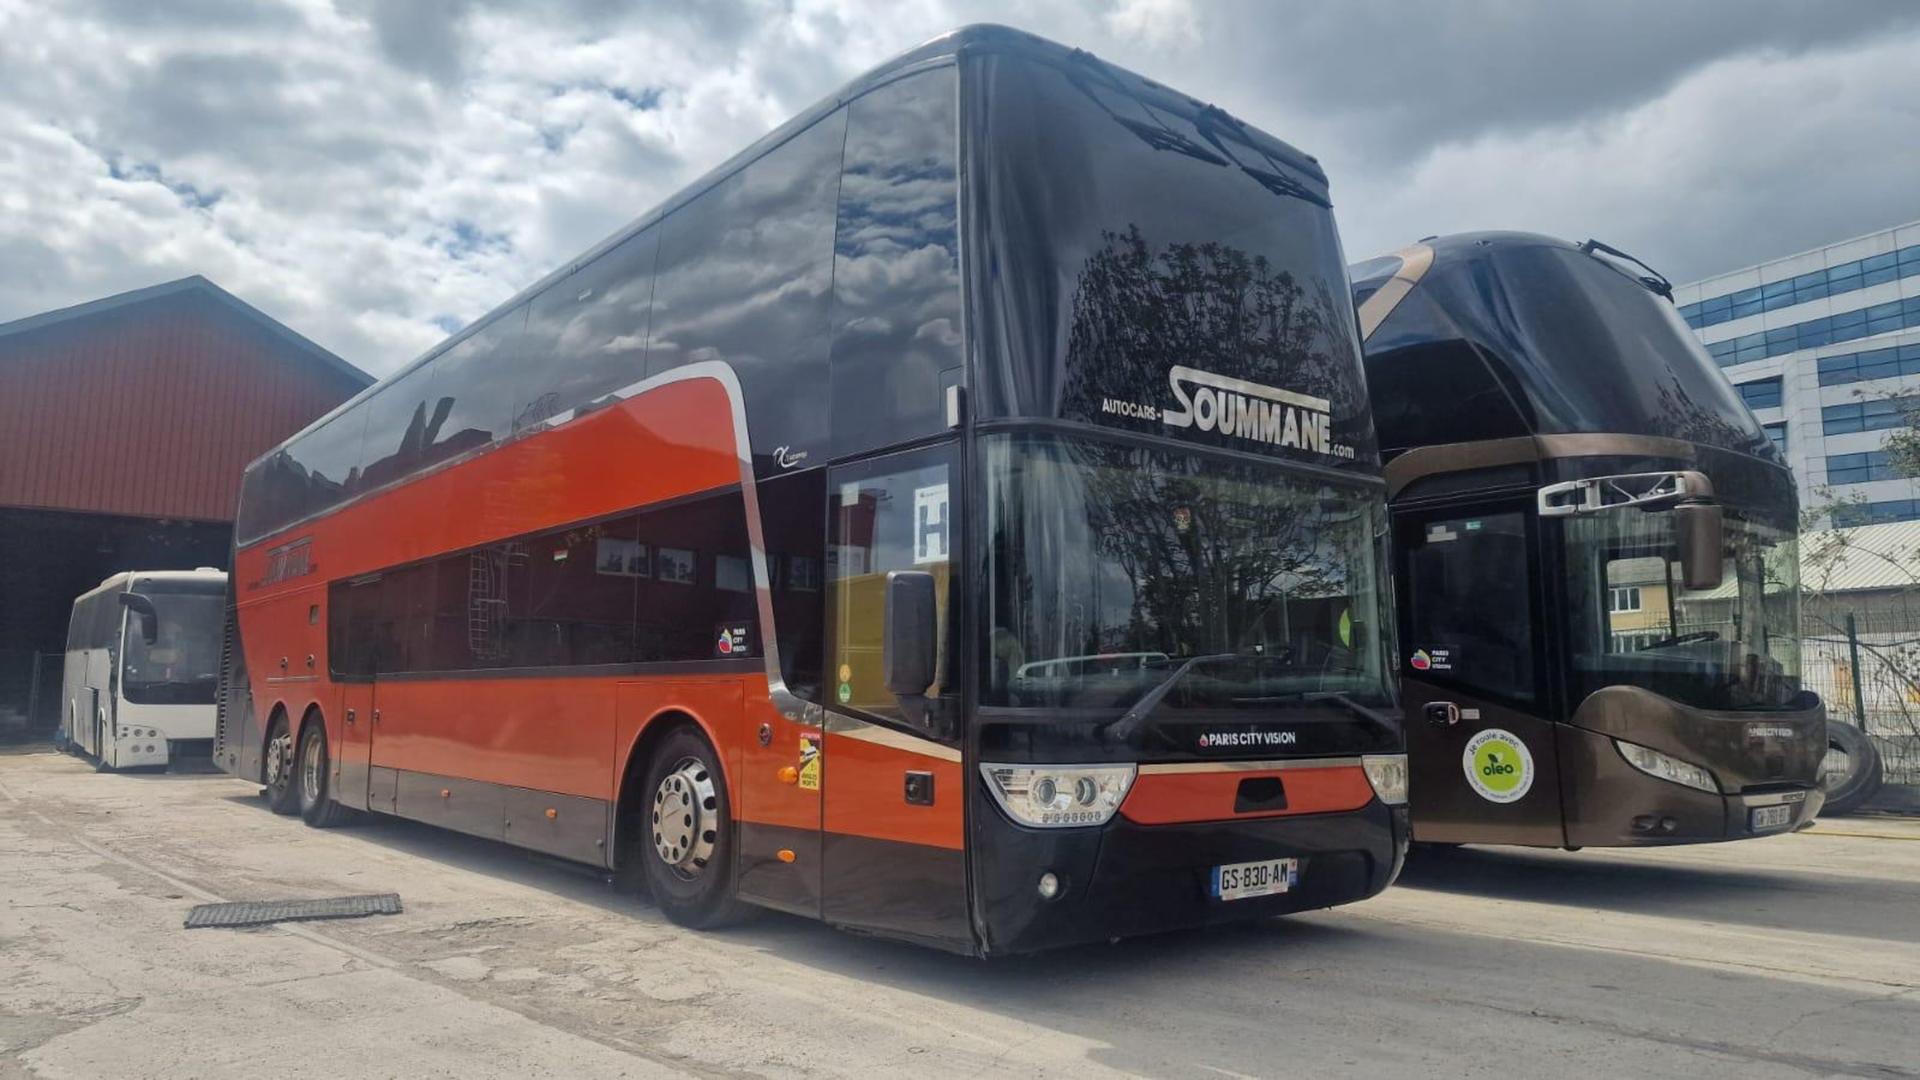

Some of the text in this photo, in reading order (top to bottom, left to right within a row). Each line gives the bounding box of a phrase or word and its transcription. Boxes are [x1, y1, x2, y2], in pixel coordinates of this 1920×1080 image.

[919, 502, 947, 558] H
[1209, 732, 1296, 746] PARIS CITY VISION
[1476, 731, 1497, 746] roule
[1499, 733, 1519, 748] avec
[1483, 762, 1514, 776] oleo
[1222, 863, 1288, 890] GS-830-AM
